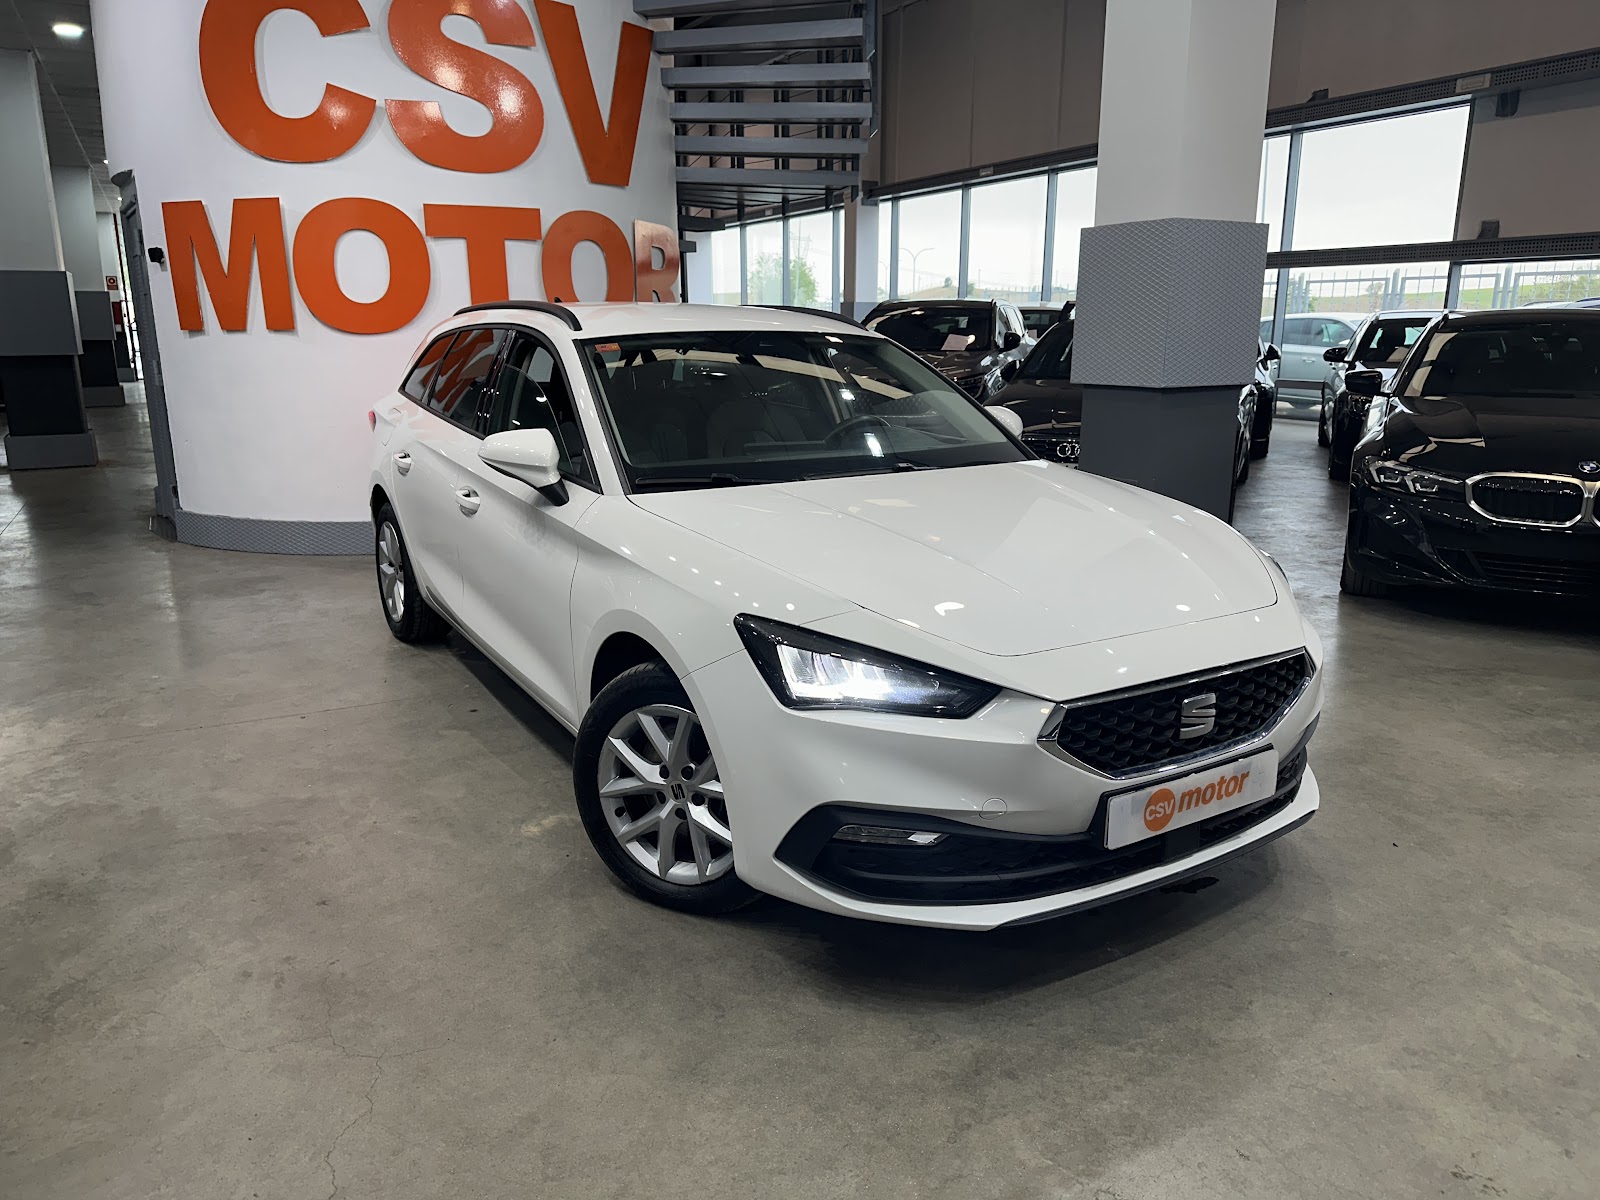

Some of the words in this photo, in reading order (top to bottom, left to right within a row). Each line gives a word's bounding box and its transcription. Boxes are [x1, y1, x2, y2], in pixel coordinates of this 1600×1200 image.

[198, 0, 654, 187] CSV
[162, 197, 679, 335] MOTOR
[1177, 771, 1249, 813] motor
